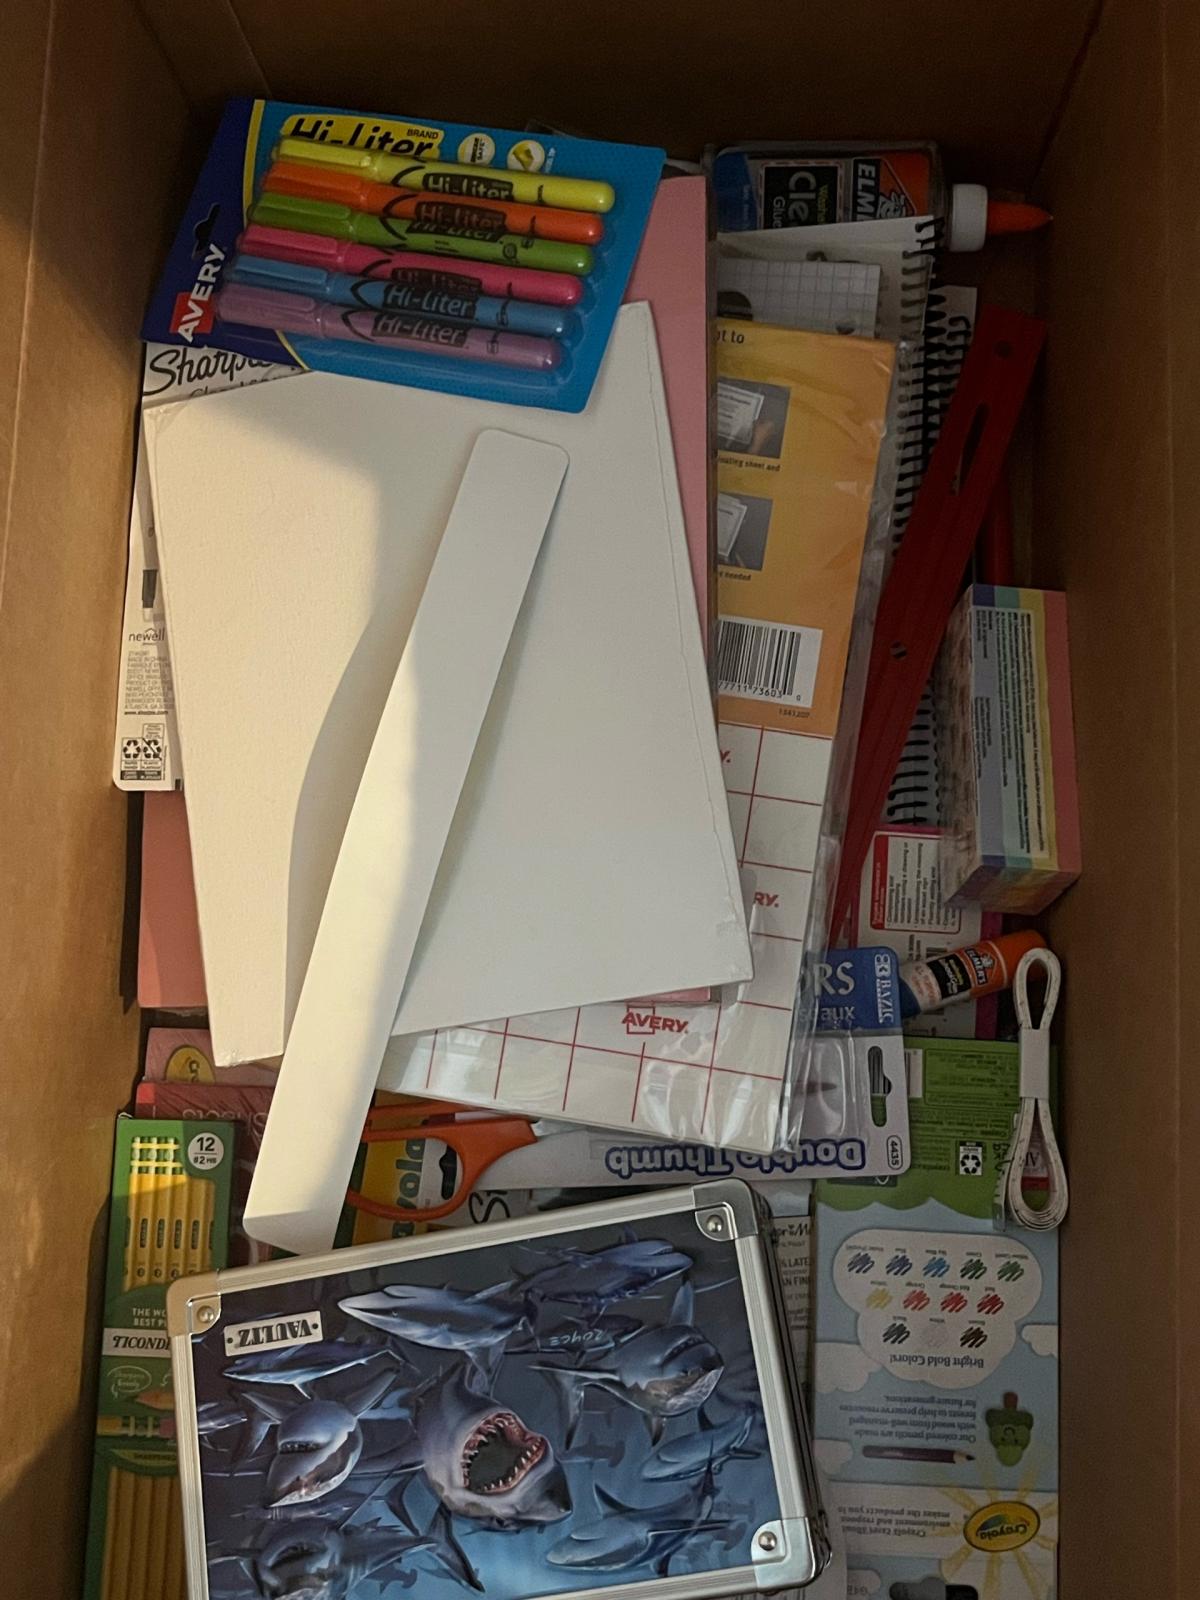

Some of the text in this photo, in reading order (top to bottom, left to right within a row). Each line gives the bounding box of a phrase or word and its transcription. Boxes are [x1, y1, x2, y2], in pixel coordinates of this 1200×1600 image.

[406, 128, 439, 140] BRAND
[177, 243, 226, 343] AVERY
[387, 287, 475, 318] Hi-Liter
[376, 314, 464, 344] Hi-Liter
[731, 331, 746, 345] to
[128, 627, 166, 642] newell
[196, 1136, 216, 1152] 12
[605, 1143, 733, 1180] Thumb
[889, 1141, 899, 1168] 4435
[131, 1307, 150, 1317] THE
[133, 1317, 156, 1327] BEST
[237, 1319, 313, 1345] VAULTZ
[890, 1354, 984, 1368] Bright Bold Colors!
[960, 1434, 976, 1443] Our
[979, 1523, 1028, 1541] Crayola
